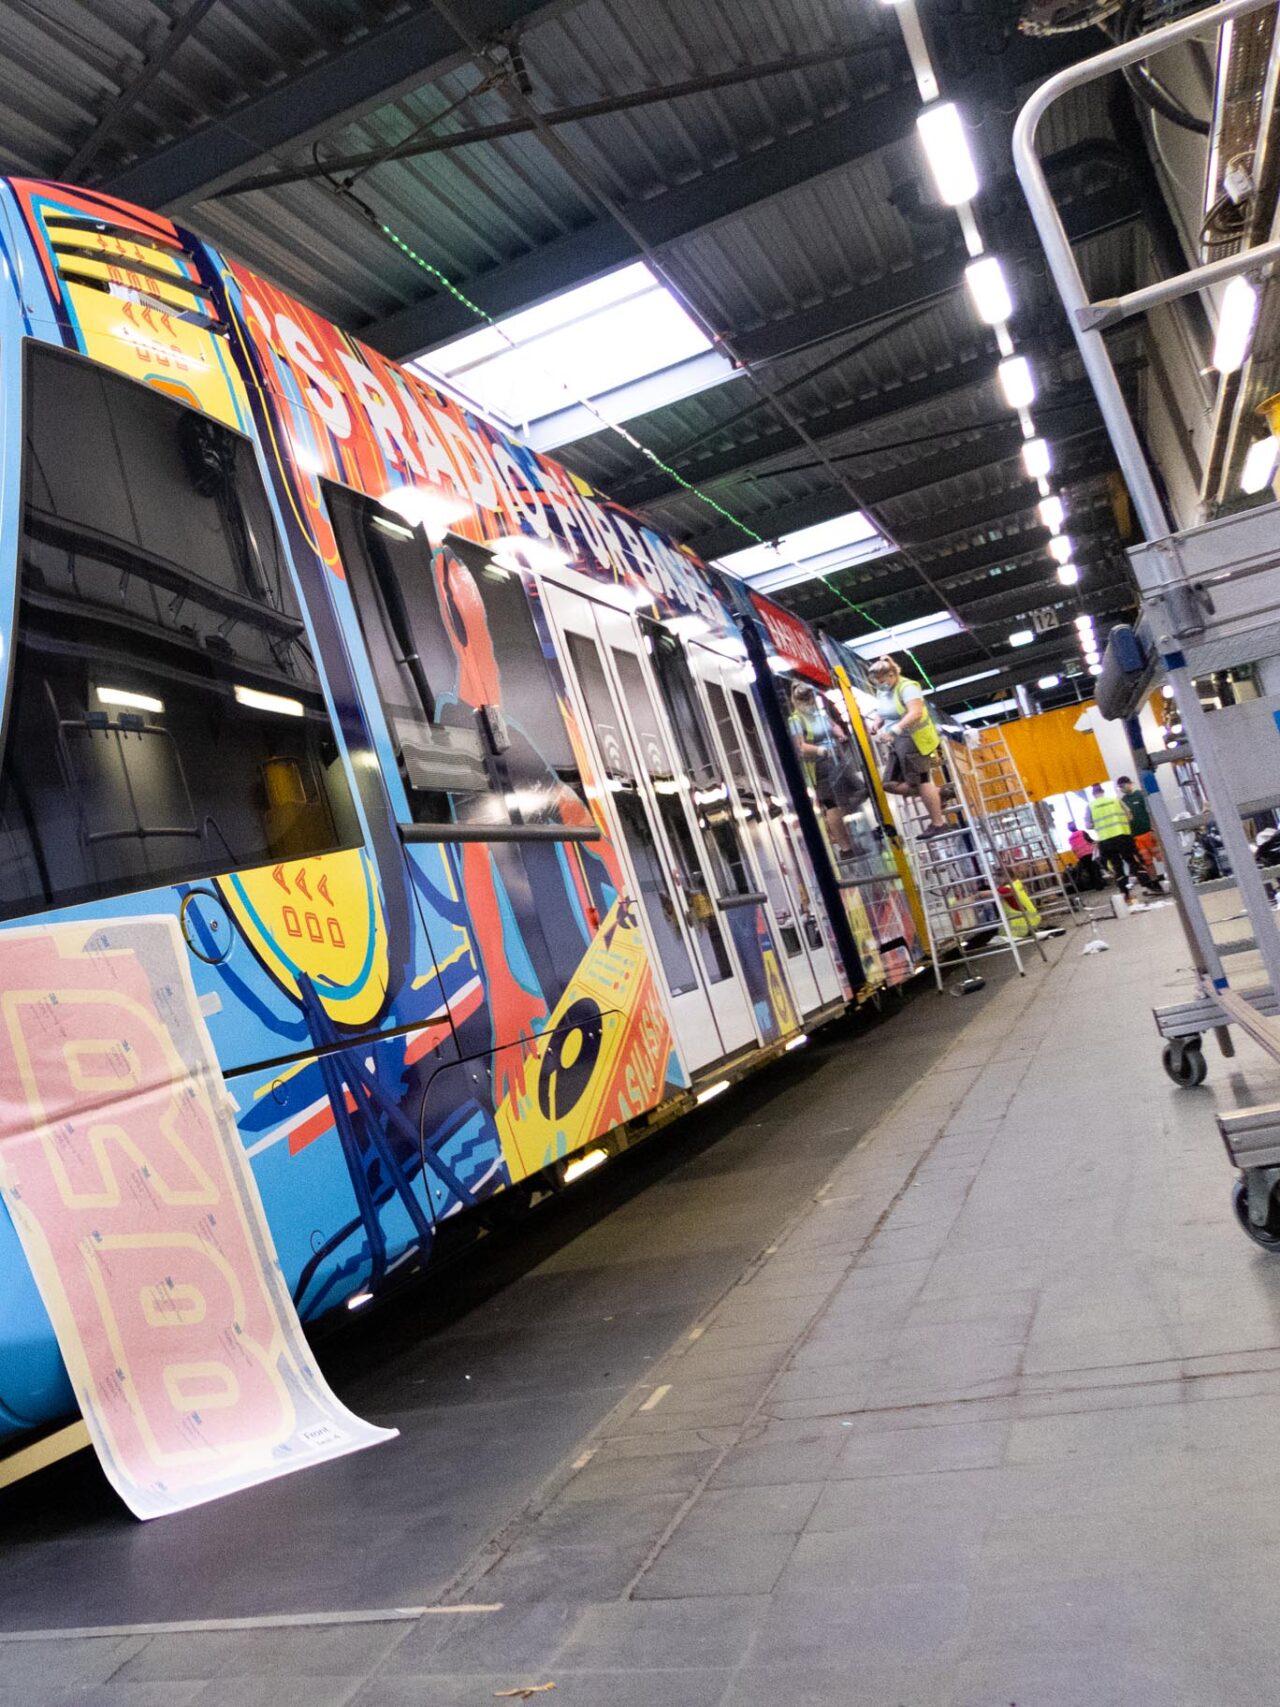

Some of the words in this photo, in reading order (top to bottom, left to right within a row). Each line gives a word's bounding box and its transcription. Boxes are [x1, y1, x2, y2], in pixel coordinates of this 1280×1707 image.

[335, 348, 549, 540] RADIO
[528, 464, 645, 580] FÜR
[611, 513, 726, 624] BASEL
[1036, 611, 1056, 629] 12
[608, 983, 666, 1131] ASILISK
